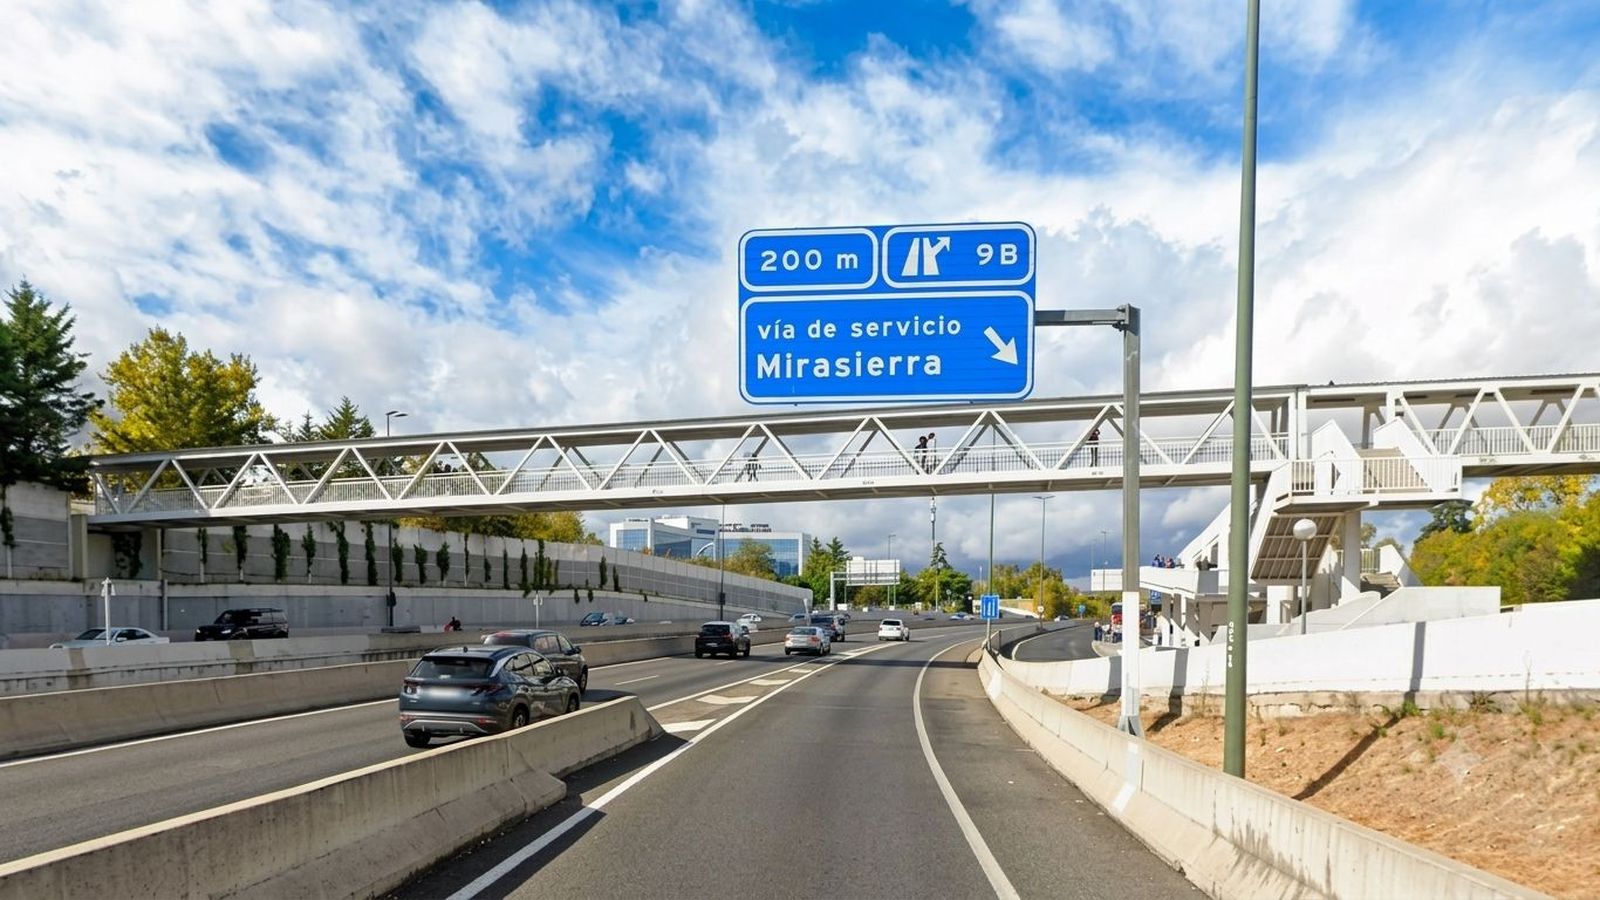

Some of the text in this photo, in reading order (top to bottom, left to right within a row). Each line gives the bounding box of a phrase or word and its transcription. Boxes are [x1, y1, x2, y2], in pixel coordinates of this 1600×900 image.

[760, 249, 859, 271] 200 m
[976, 243, 1018, 265] 9B
[757, 315, 962, 339] vía de servicio
[756, 351, 942, 379] Mirasierra
